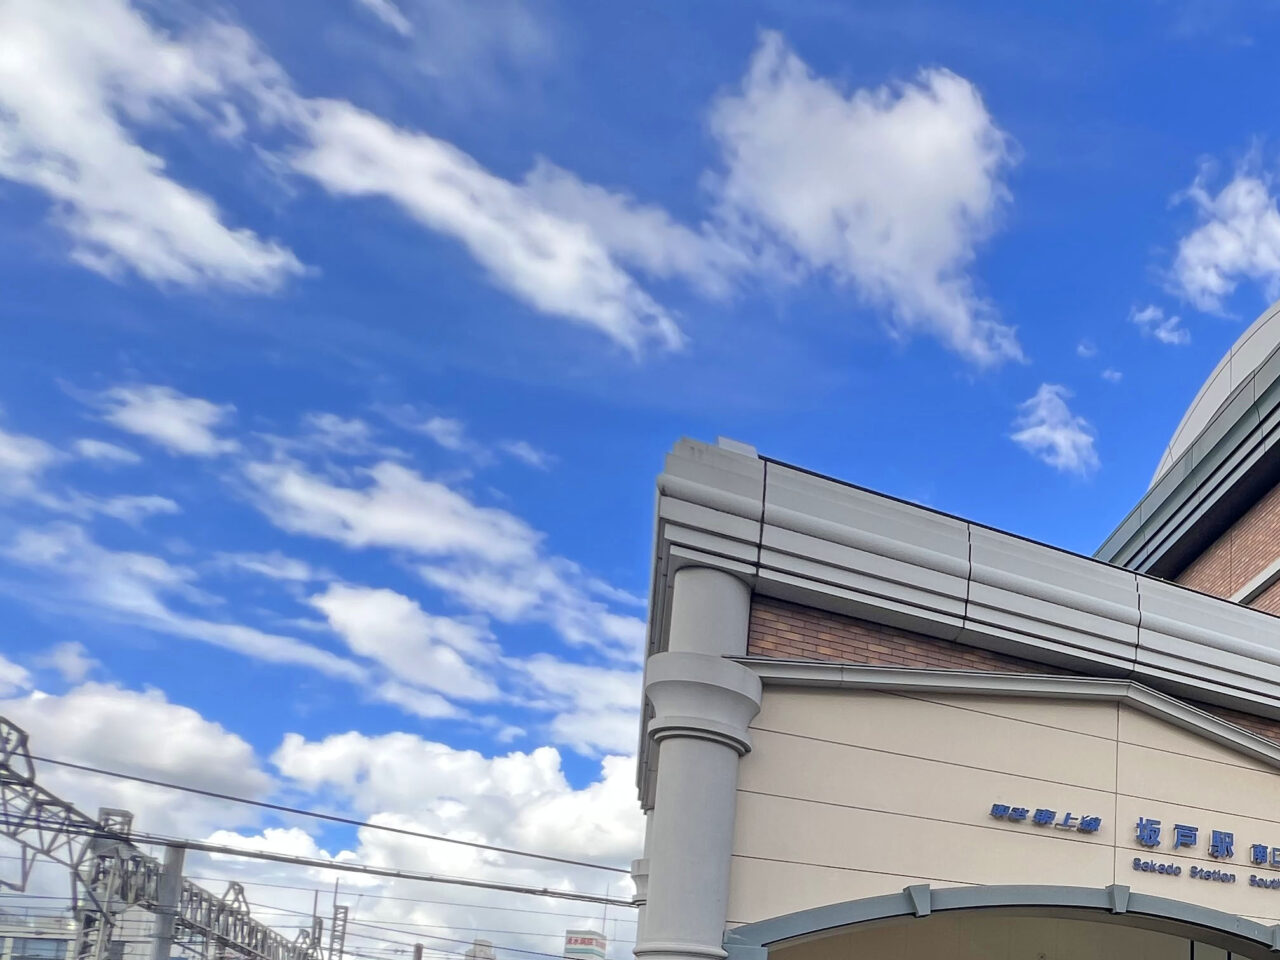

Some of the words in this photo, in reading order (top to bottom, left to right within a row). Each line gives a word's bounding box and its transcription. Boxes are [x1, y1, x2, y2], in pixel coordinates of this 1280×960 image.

[1135, 816, 1235, 858] 坂戸駅
[1132, 857, 1182, 876] Sakado
[1189, 865, 1236, 883] Station
